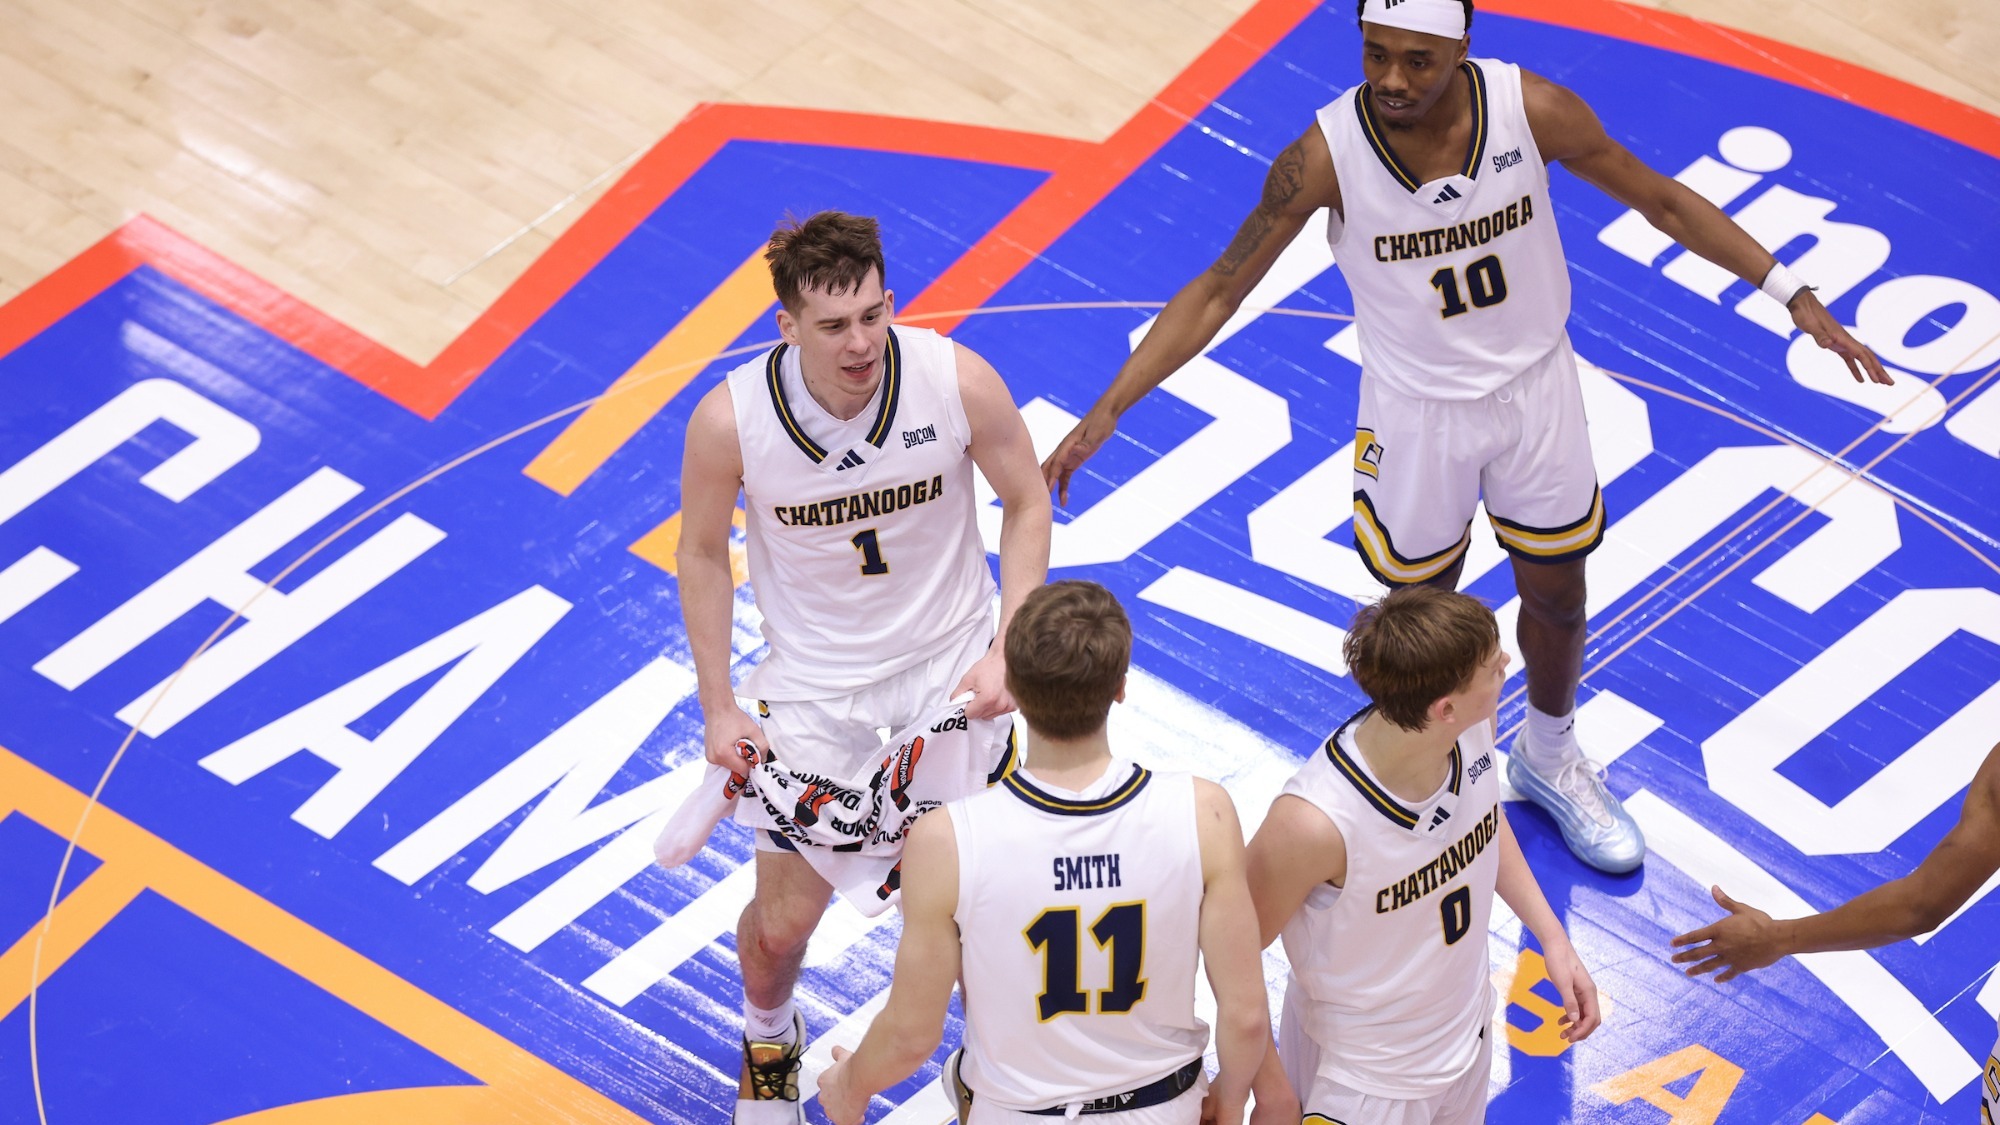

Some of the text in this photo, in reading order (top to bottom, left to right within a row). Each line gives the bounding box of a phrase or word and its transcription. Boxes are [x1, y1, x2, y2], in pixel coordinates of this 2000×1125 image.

[1374, 194, 1533, 262] CHATTANOOGA
[1429, 253, 1508, 320] 10
[1596, 125, 2000, 460] ing
[774, 474, 943, 527] CHATTANOOGA
[851, 528, 890, 576] 1
[1053, 853, 1121, 891] SMITH
[1376, 802, 1498, 914] CHATTANOOGA
[1440, 884, 1471, 947] 0
[1021, 899, 1149, 1024] 11
